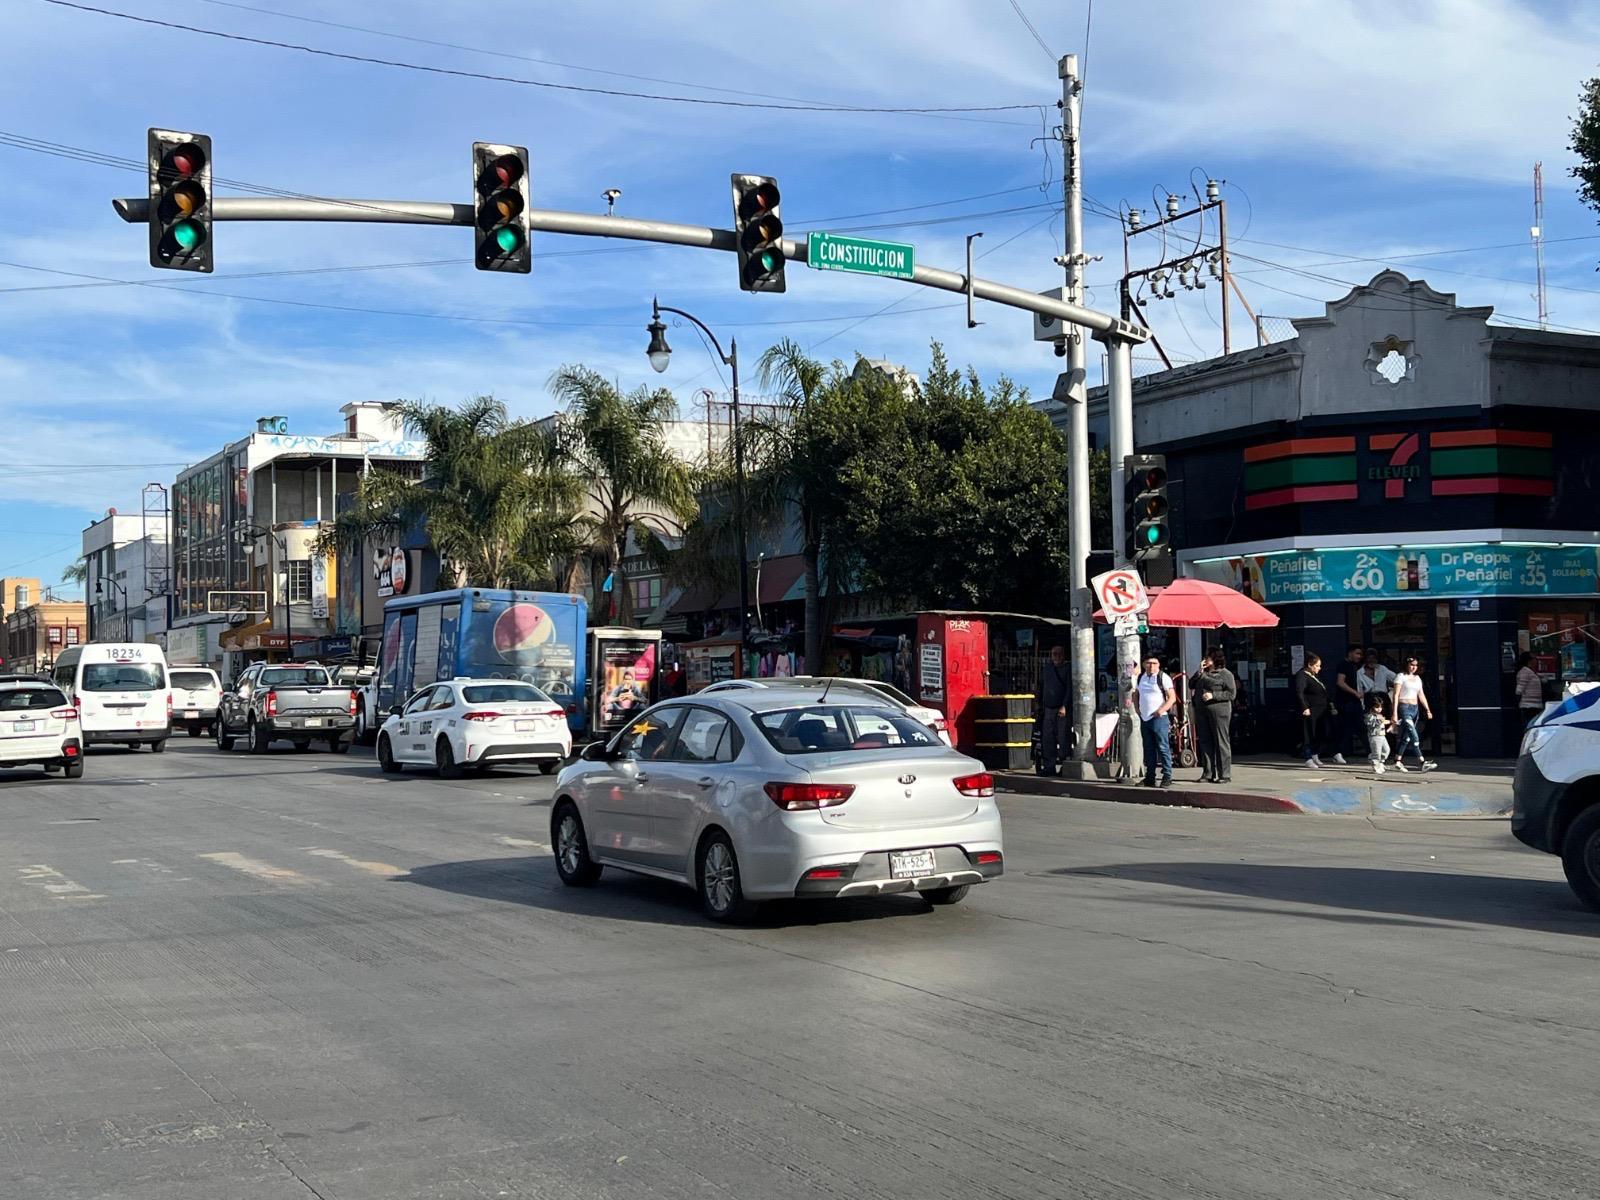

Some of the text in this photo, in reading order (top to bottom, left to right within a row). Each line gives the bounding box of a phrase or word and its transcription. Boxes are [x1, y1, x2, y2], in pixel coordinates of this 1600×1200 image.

[820, 242, 905, 269] CONSTITUCION
[1369, 433, 1420, 499] 7
[1270, 556, 1321, 573] Peñafiel
[1356, 553, 1378, 568] 2x
[1441, 552, 1460, 565] Dr
[1526, 551, 1542, 564] 2x
[1343, 568, 1385, 591] $60
[1445, 568, 1513, 585] y Peñafiel
[1520, 564, 1547, 586] $35
[1270, 583, 1281, 594] Dr
[1283, 581, 1325, 594] Pepper
[106, 648, 142, 659] 18234
[901, 775, 914, 784] KIA
